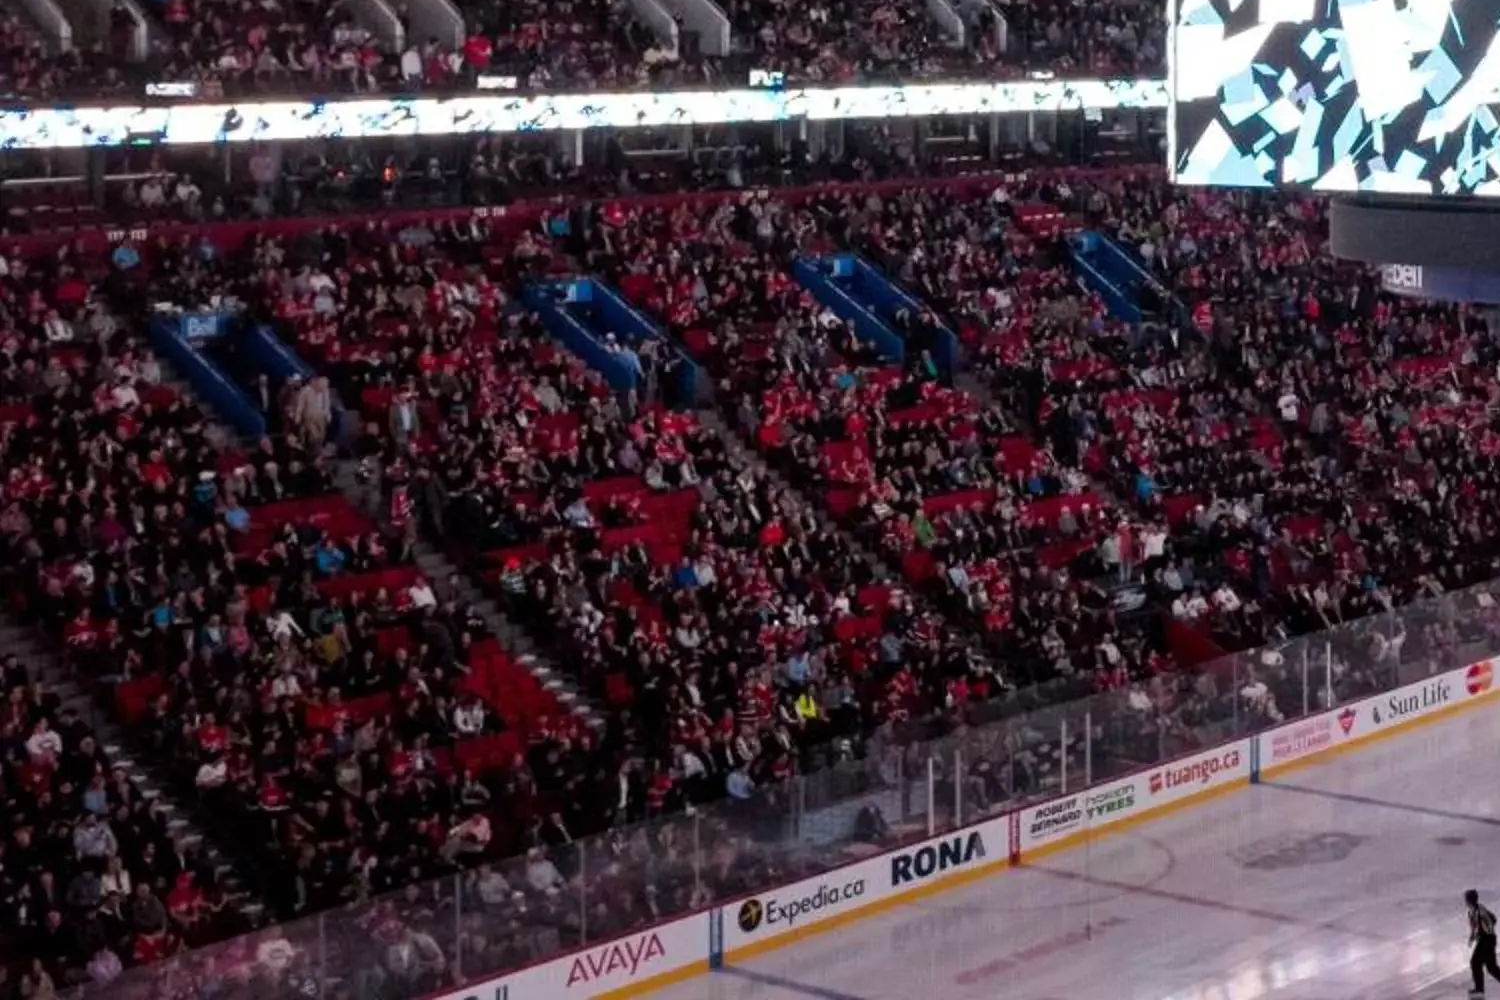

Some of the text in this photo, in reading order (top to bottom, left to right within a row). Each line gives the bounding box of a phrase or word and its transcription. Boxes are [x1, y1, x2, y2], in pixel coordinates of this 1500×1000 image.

[1388, 679, 1451, 720] Sun Life
[1165, 750, 1241, 789] tuango.ca
[1086, 796, 1135, 820] TYRES
[891, 831, 986, 887] RONA
[766, 878, 866, 926] Expedia.ca
[565, 932, 666, 988] AVAYA
